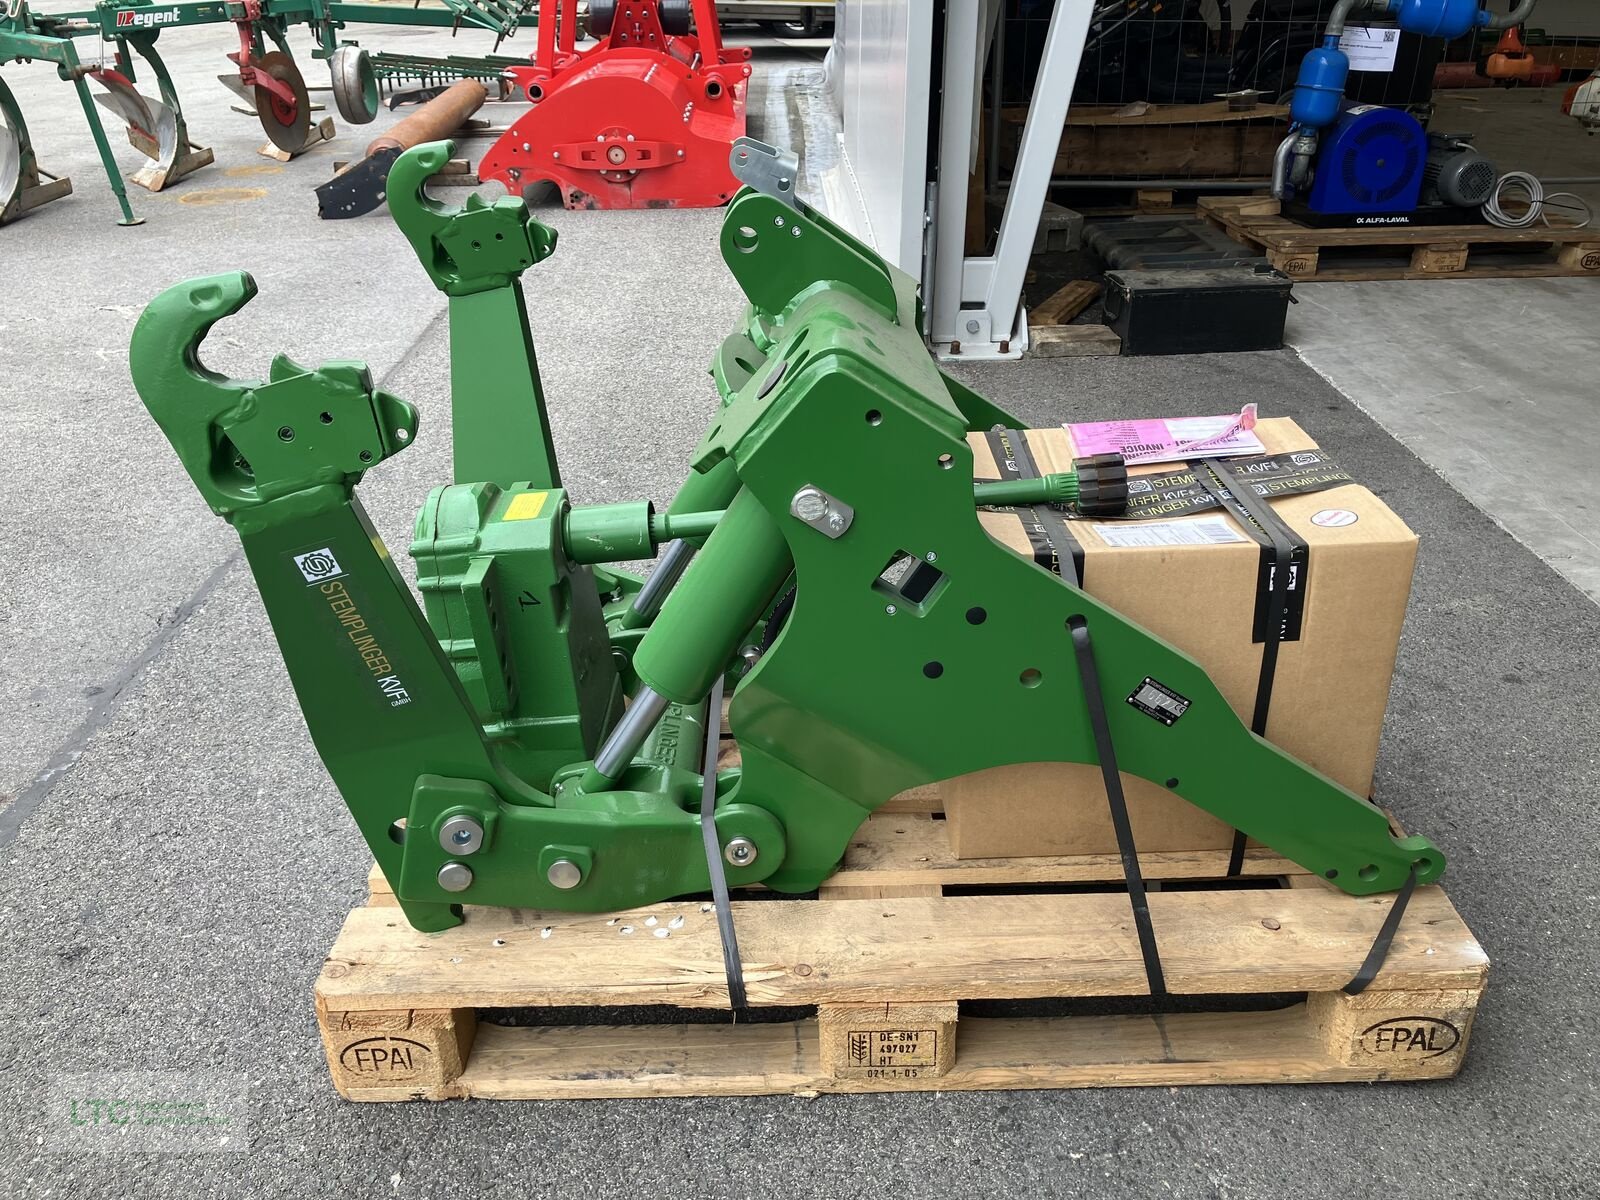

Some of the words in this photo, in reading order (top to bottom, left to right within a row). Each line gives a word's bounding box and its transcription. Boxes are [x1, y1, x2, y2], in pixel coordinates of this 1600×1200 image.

[116, 7, 180, 27] Regent
[1585, 255, 1600, 266] EPA
[1120, 443, 1164, 454] INVOICE
[1268, 472, 1350, 491] STEMPLING
[320, 581, 392, 676] STEMPLINGER
[377, 674, 409, 699] KVF
[879, 1032, 919, 1042] DE-SN1
[1374, 1027, 1443, 1052] EPAL
[879, 1044, 917, 1053] 497027
[879, 1056, 893, 1065] HT
